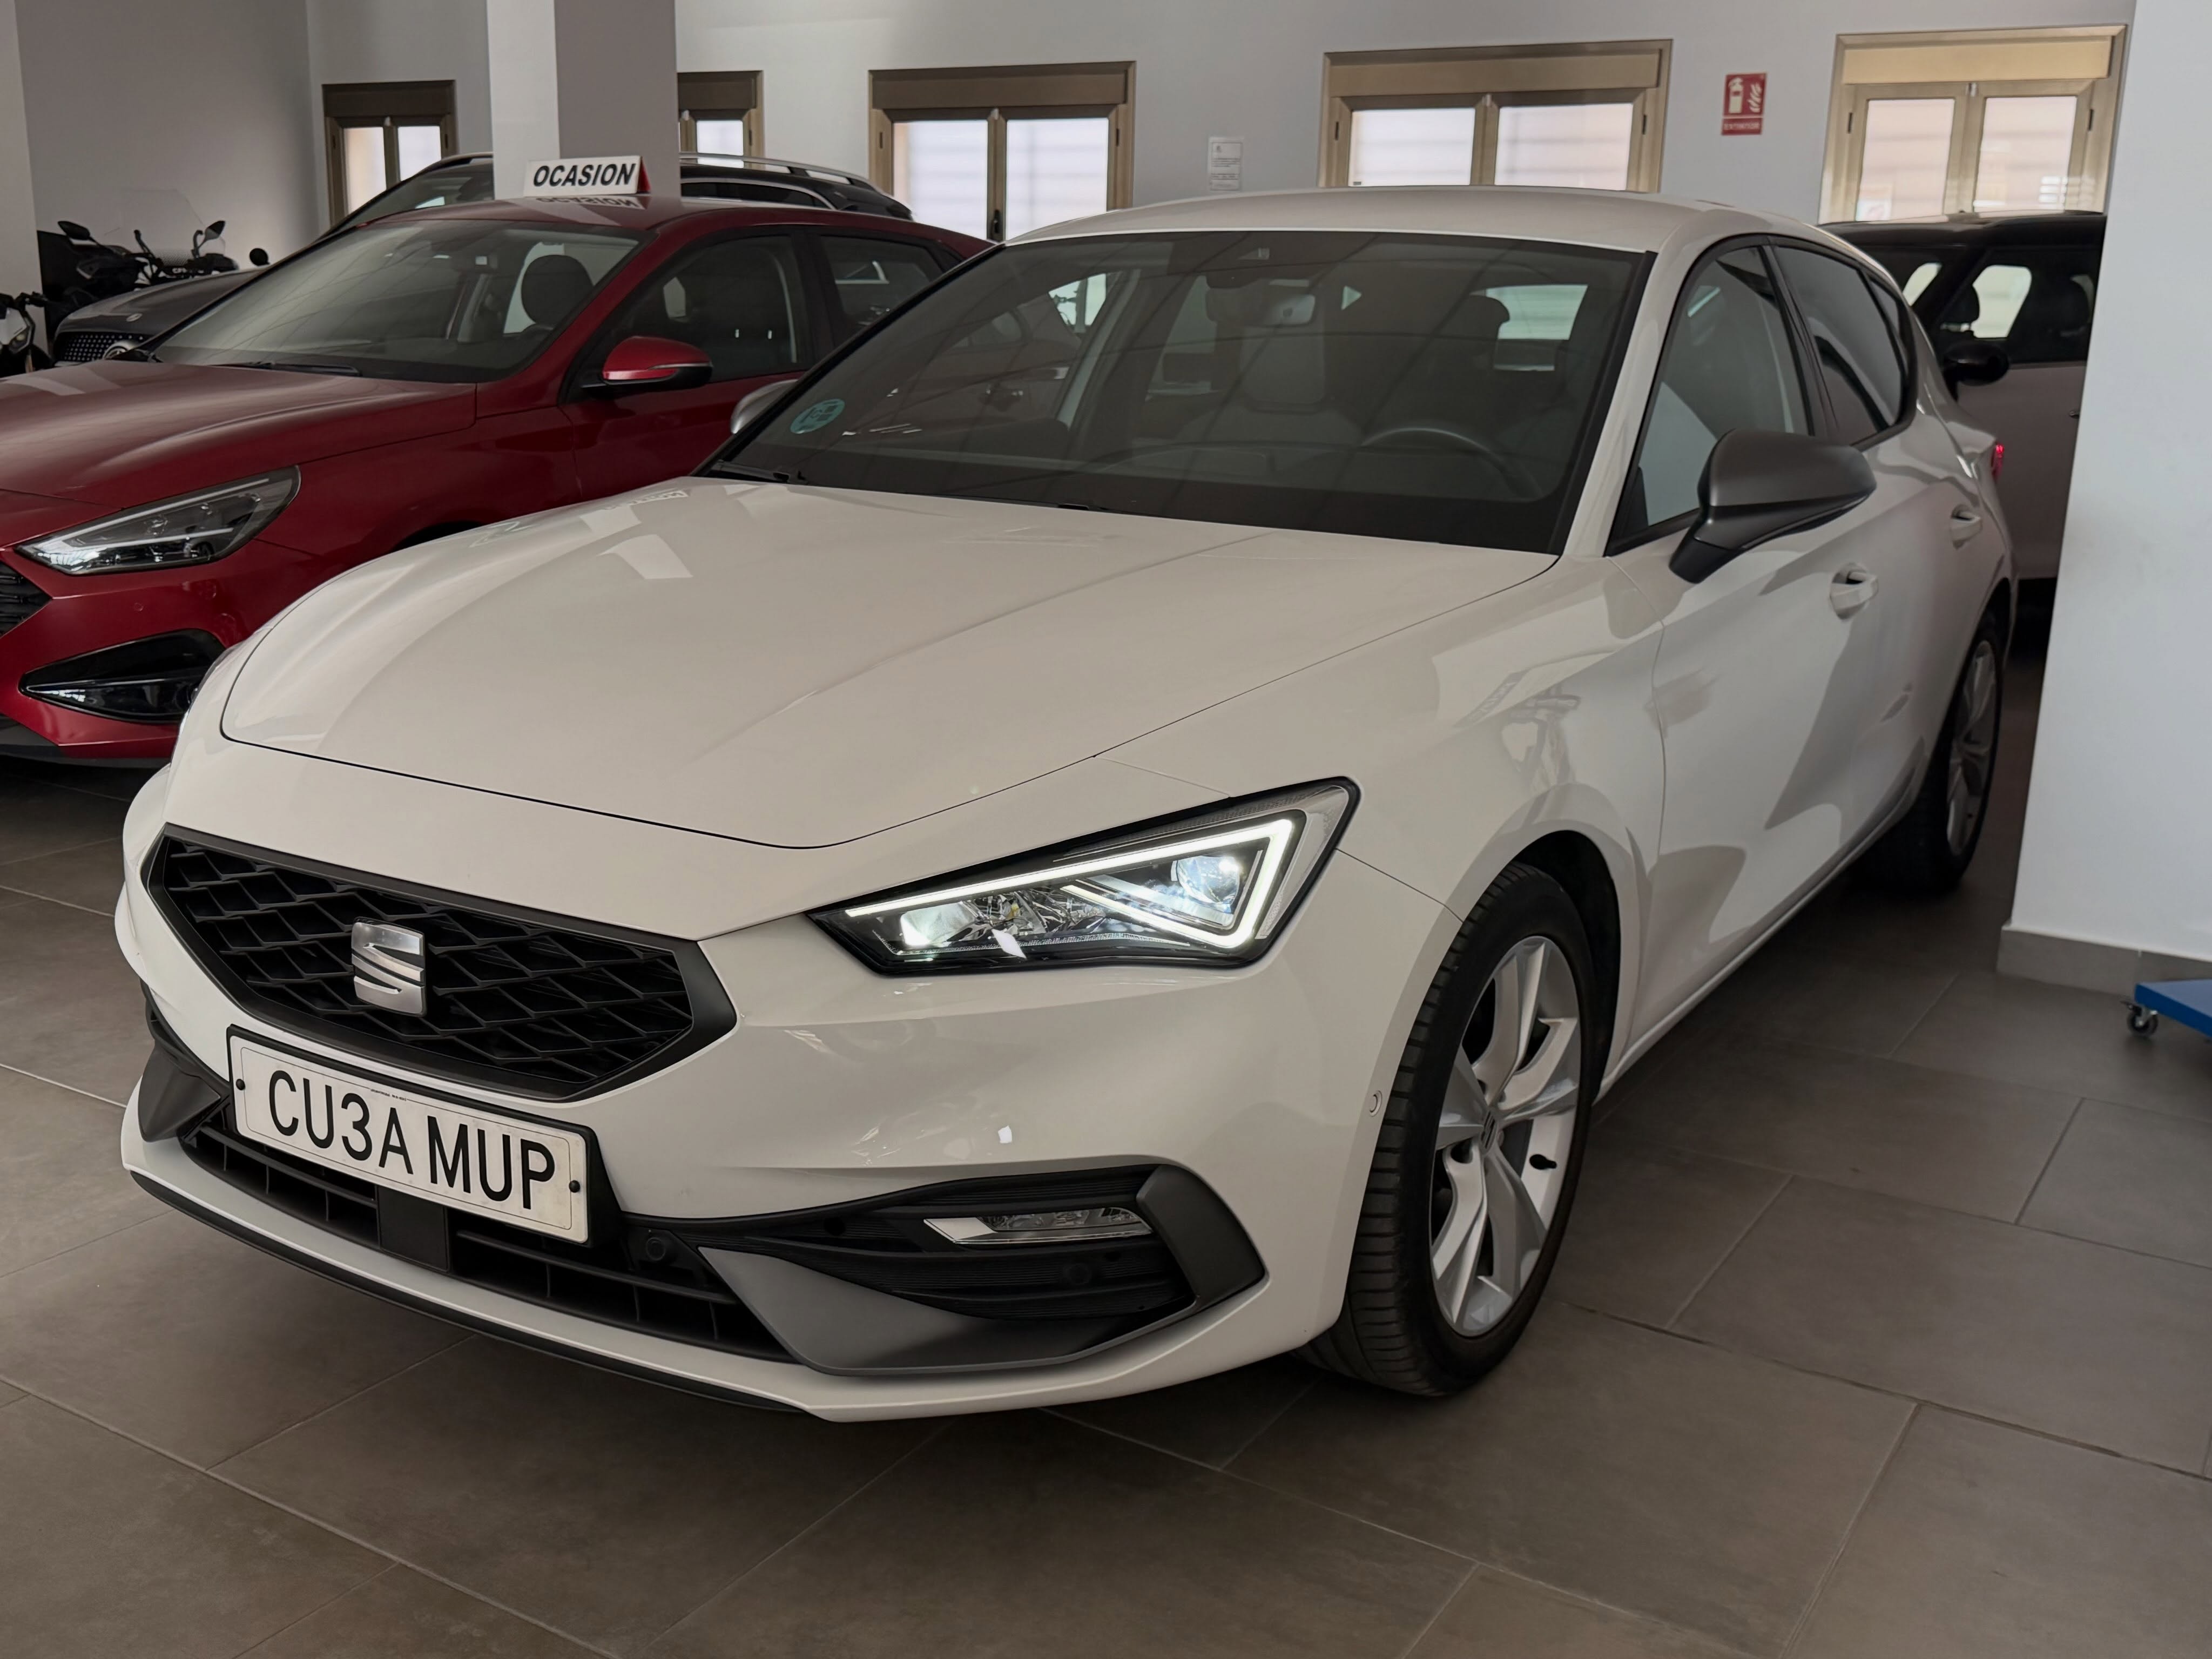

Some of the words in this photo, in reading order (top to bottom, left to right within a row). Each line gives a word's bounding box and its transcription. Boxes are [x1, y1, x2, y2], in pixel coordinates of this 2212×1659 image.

[533, 163, 636, 187] OCASION
[269, 1070, 413, 1175] CU3A
[427, 1115, 555, 1210] MUP
